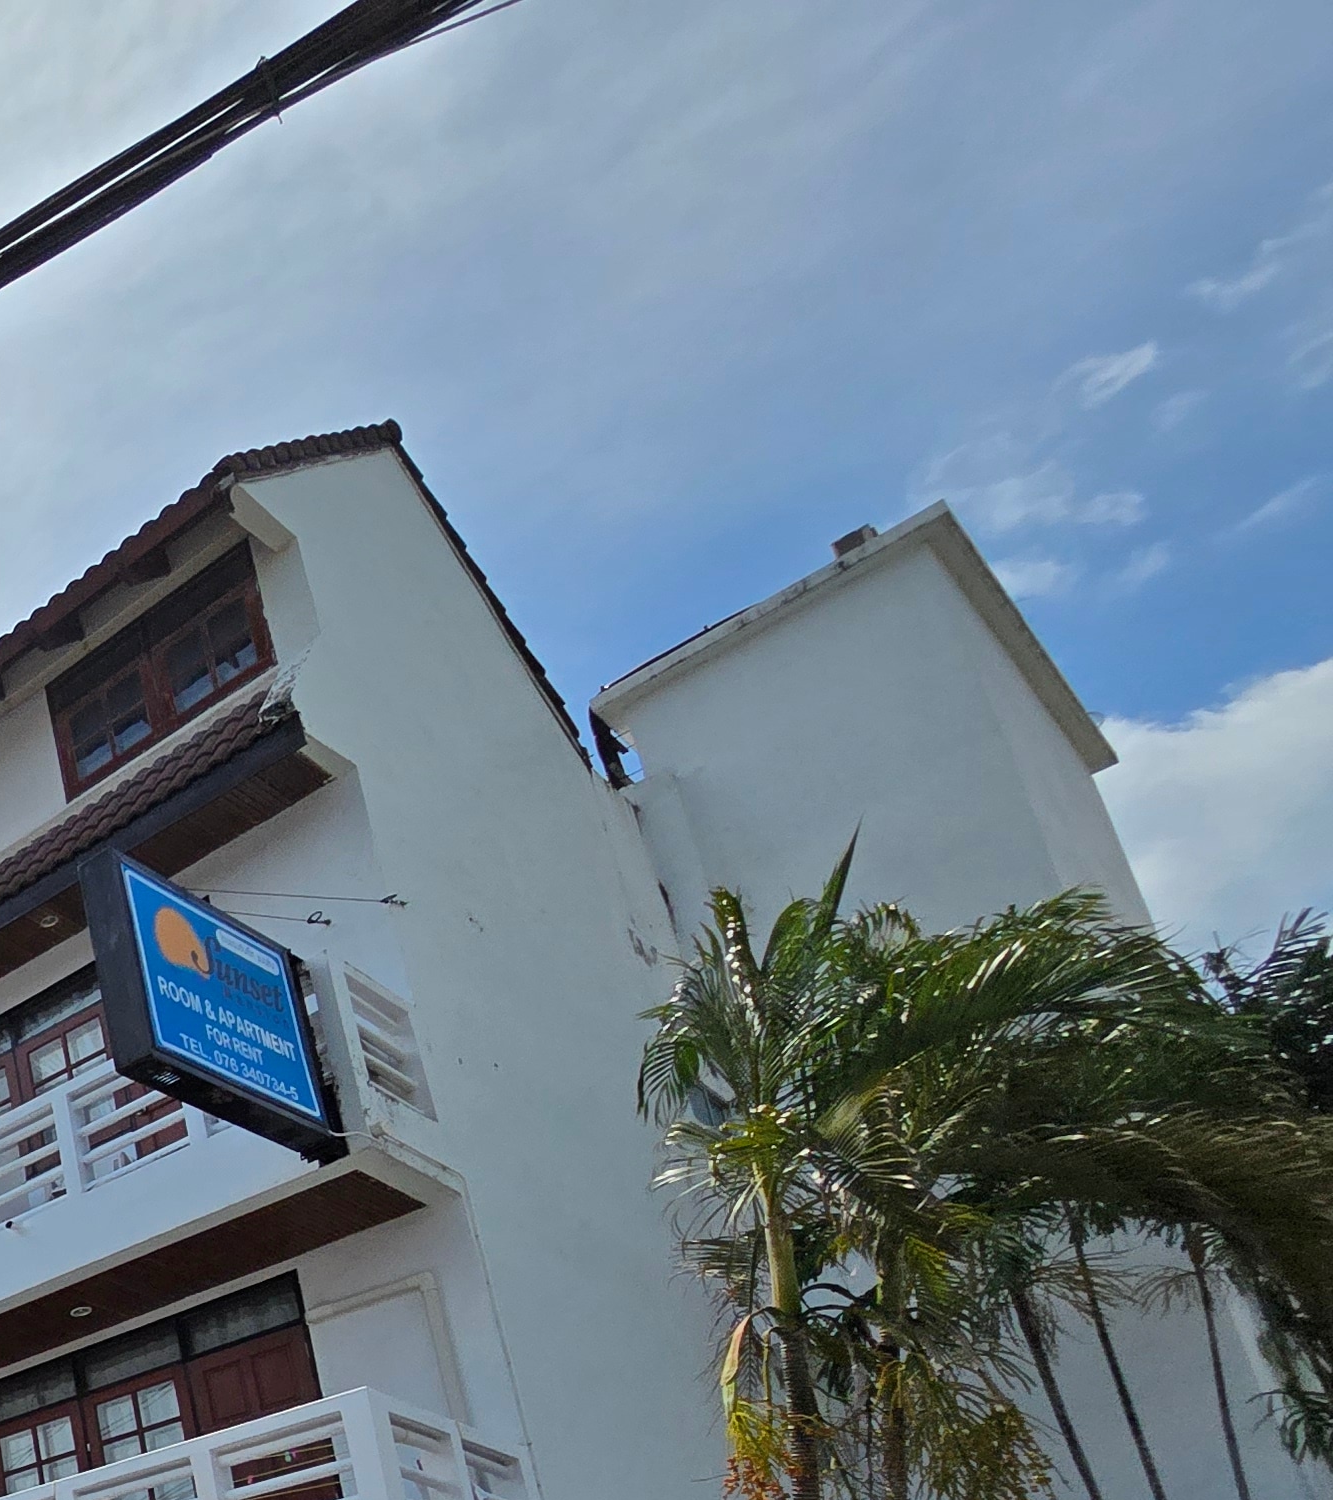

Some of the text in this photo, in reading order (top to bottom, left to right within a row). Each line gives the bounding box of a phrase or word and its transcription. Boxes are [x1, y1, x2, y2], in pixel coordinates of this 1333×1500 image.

[191, 936, 284, 1012] Sunset
[157, 976, 296, 1062] ROOM & APARTMENT
[179, 1033, 212, 1061] TEL.
[206, 1024, 264, 1066] FOR RENT
